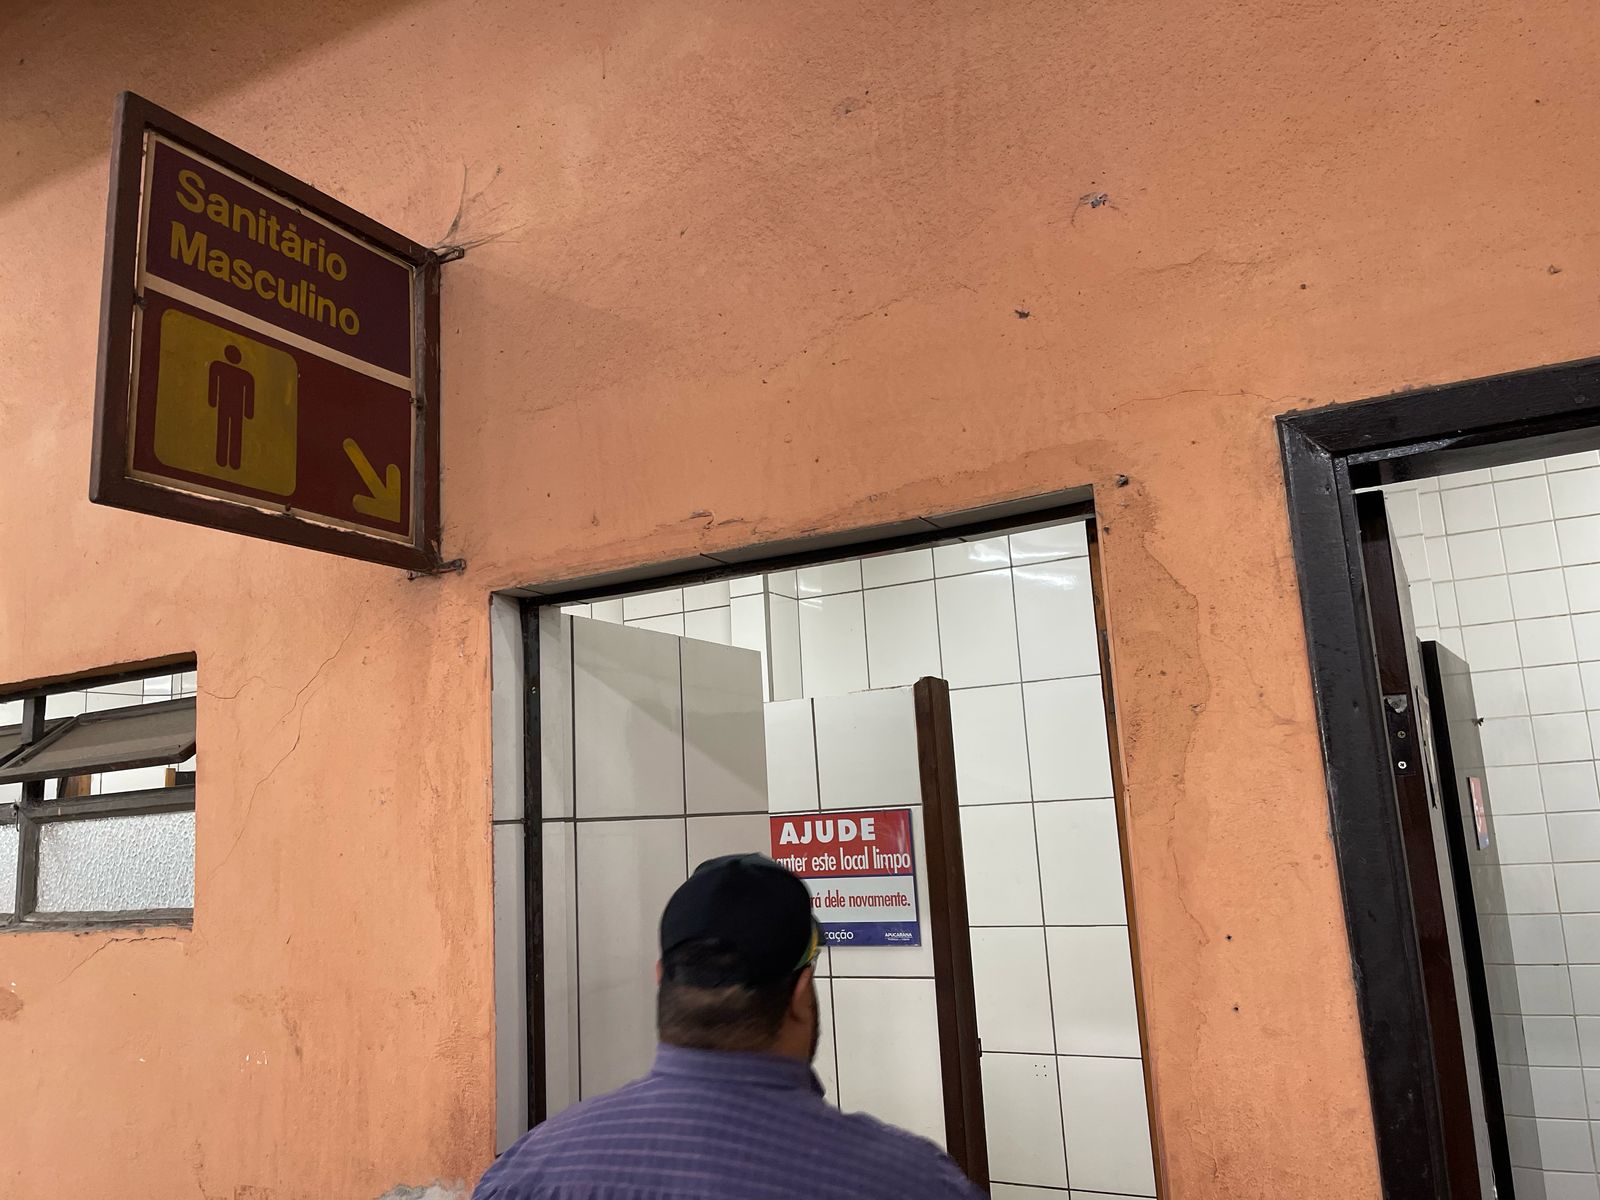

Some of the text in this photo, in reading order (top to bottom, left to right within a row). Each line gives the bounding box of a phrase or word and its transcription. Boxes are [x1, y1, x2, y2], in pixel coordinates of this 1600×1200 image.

[170, 221, 360, 335] Masculino
[779, 817, 876, 845] AJUDE
[774, 845, 911, 874] anter este local limpo
[824, 889, 846, 908] dele
[849, 892, 911, 908] novamente.
[824, 929, 854, 943] cação
